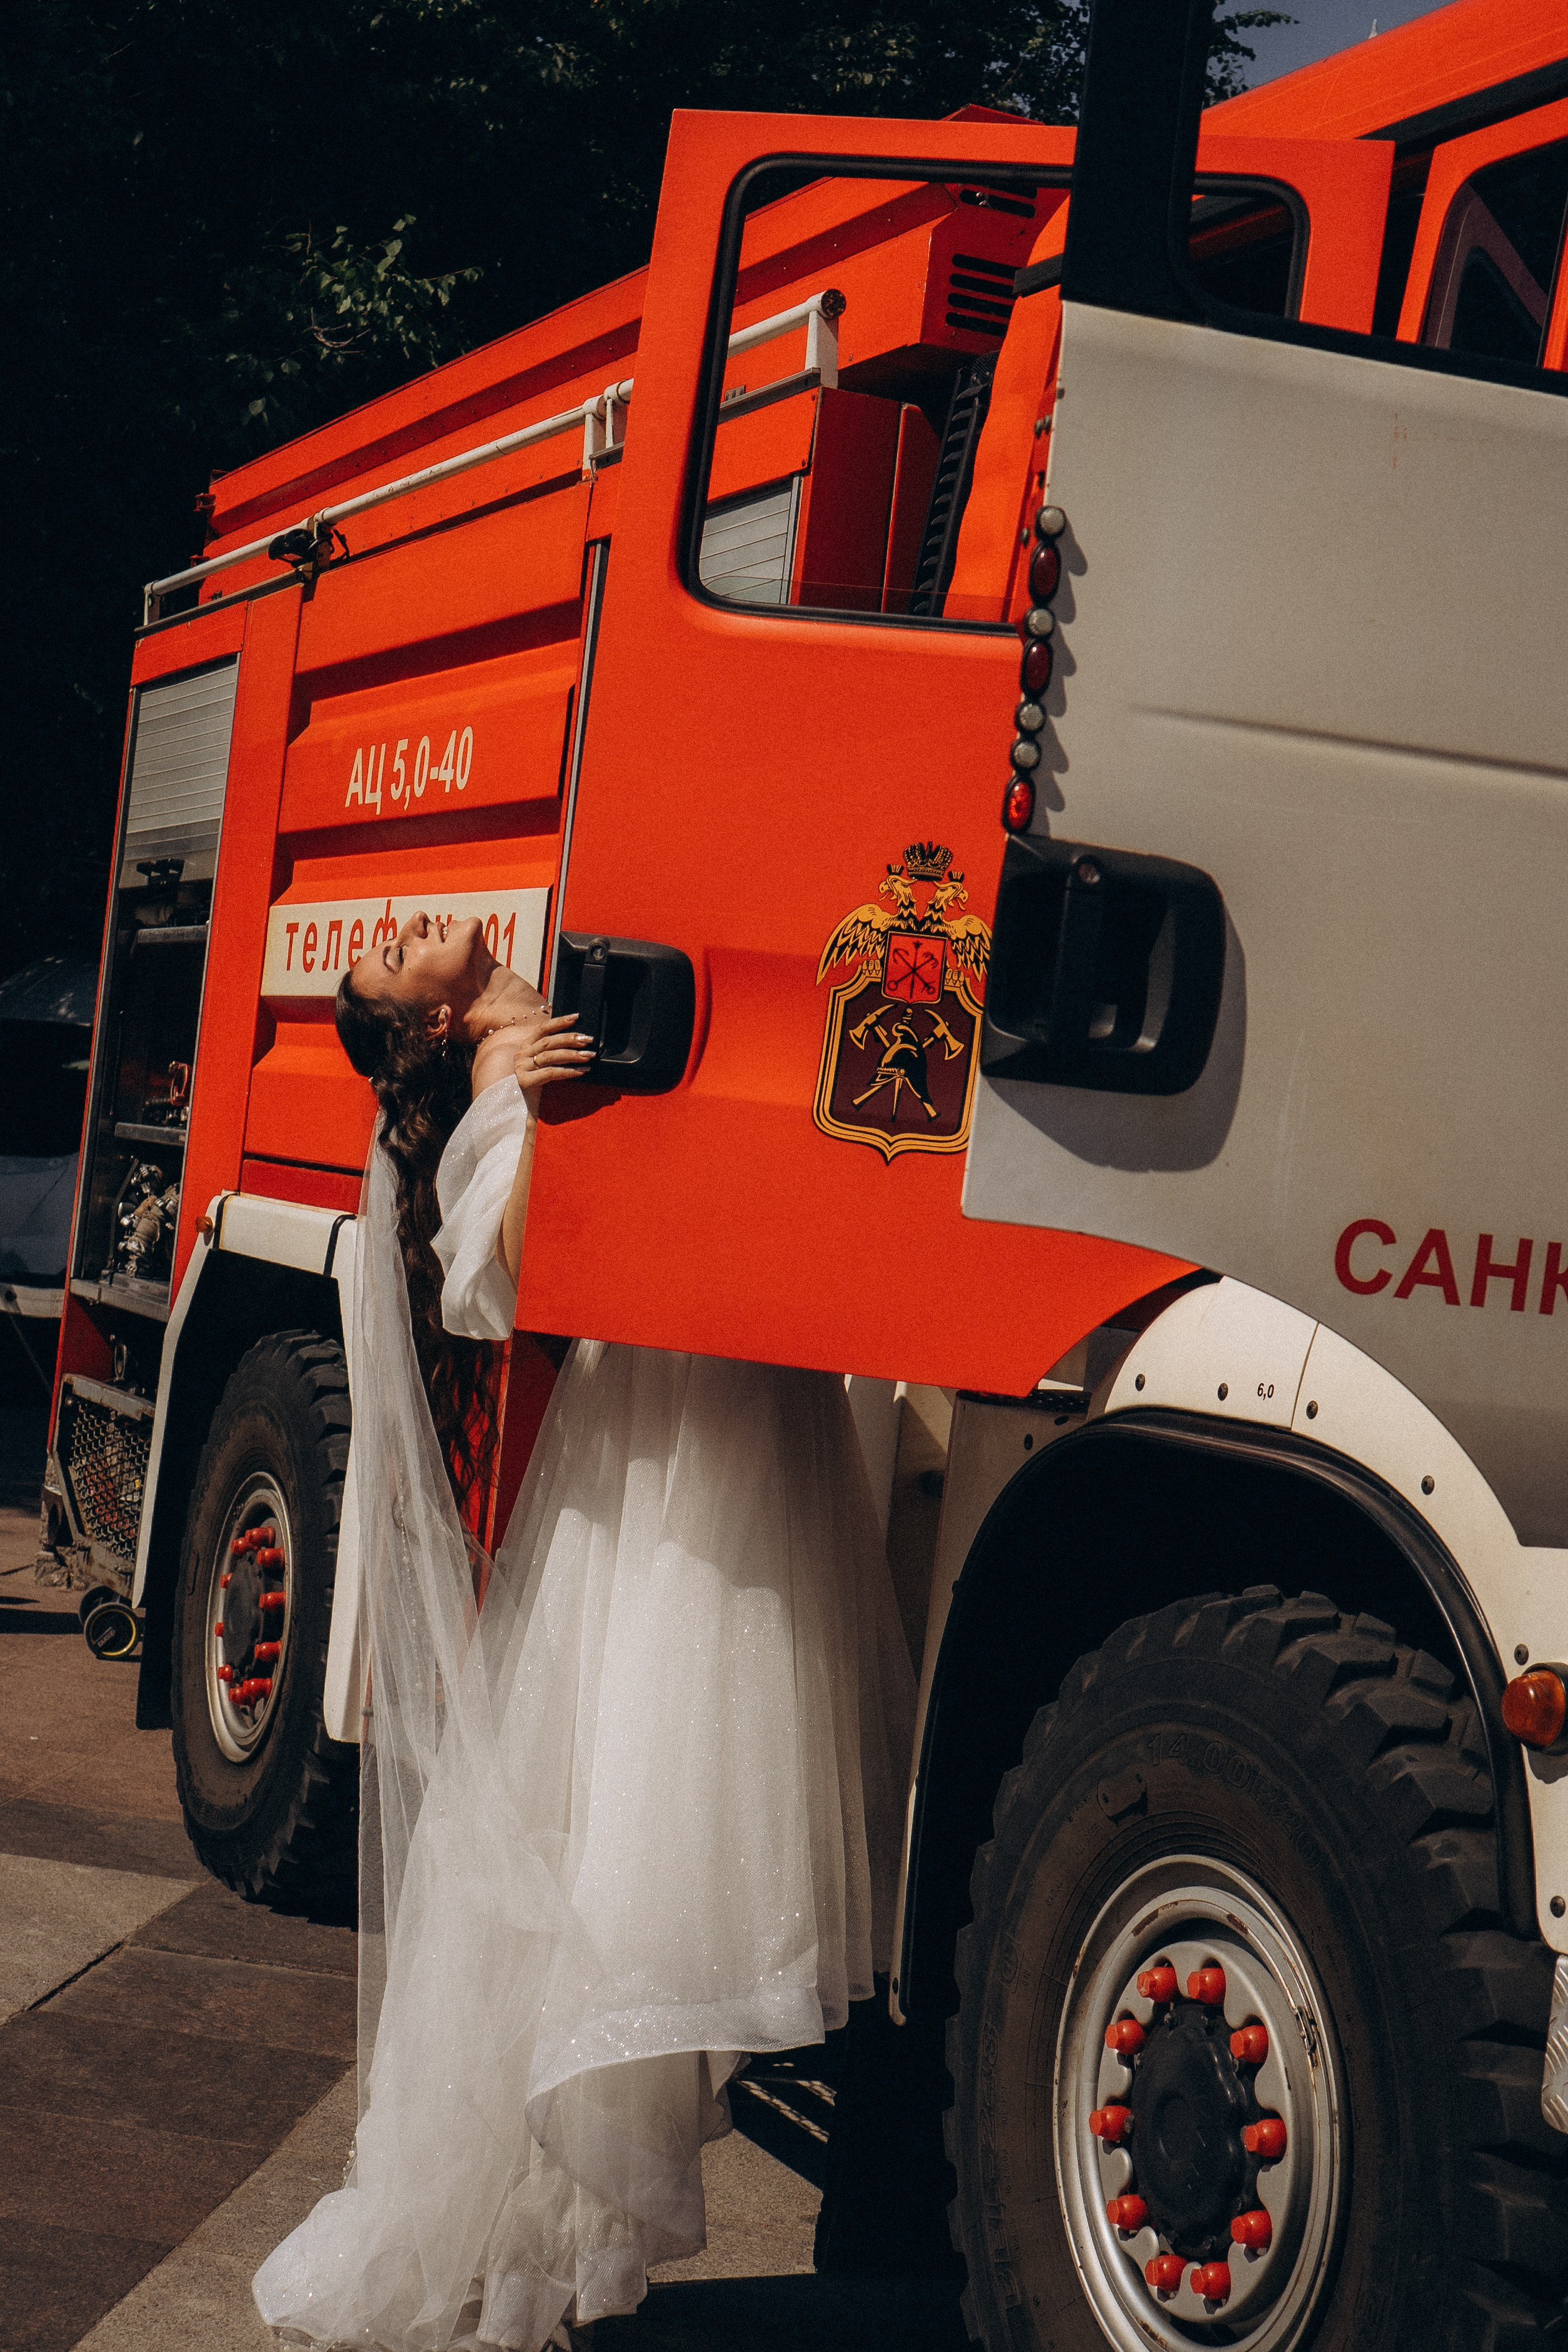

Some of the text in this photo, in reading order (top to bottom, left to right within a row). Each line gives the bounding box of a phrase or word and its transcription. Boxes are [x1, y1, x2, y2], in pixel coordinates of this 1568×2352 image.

[345, 725, 474, 815] АЦ 5,0-40
[1257, 1382, 1275, 1401] 6,0
